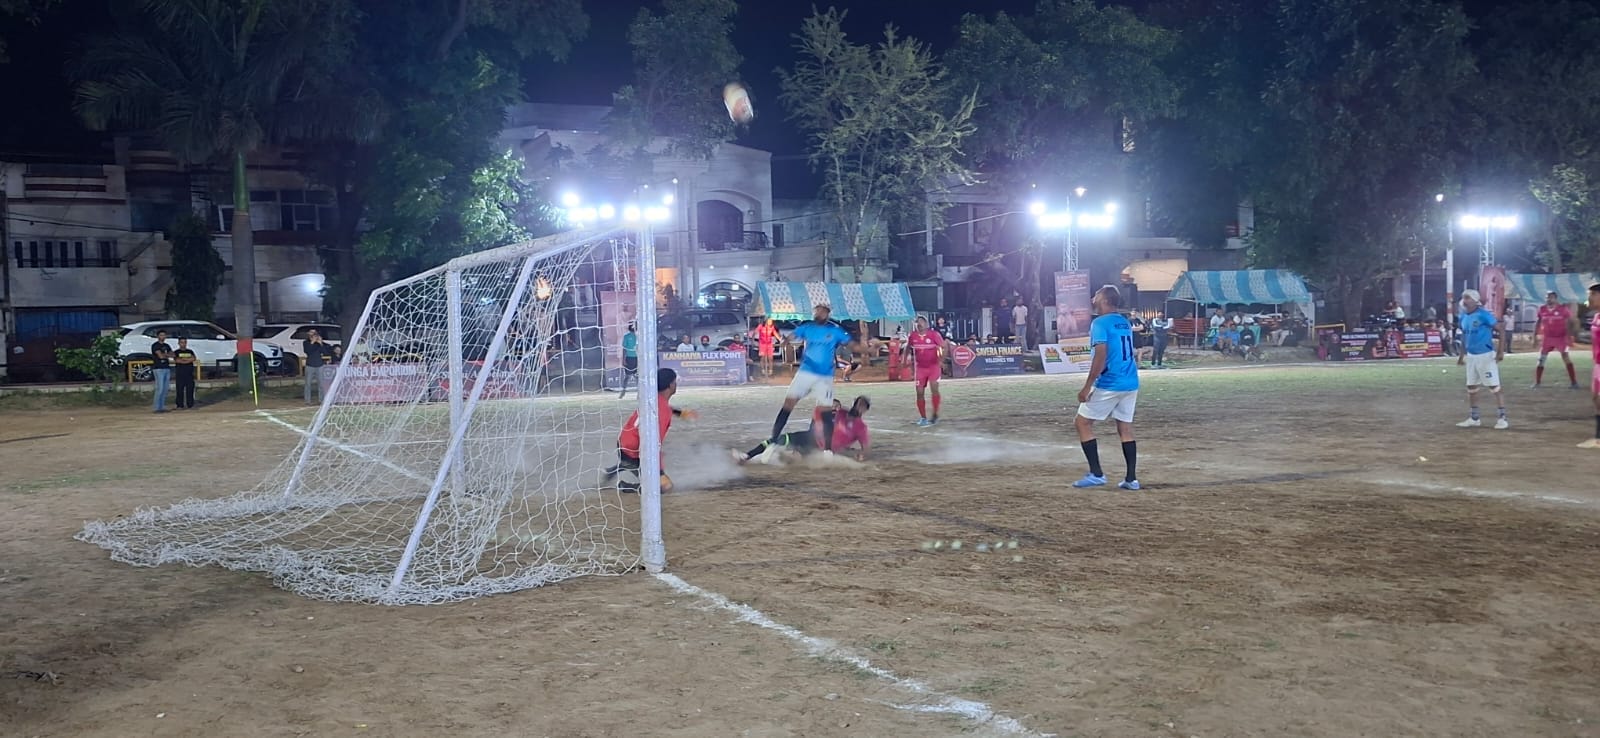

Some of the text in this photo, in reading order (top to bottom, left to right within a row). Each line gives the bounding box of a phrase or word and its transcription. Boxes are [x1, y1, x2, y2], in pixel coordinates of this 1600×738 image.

[999, 346, 1022, 355] FINANCE
[1120, 335, 1133, 361] 11
[663, 352, 702, 360] KANHAIYA
[719, 351, 741, 359] POINT
